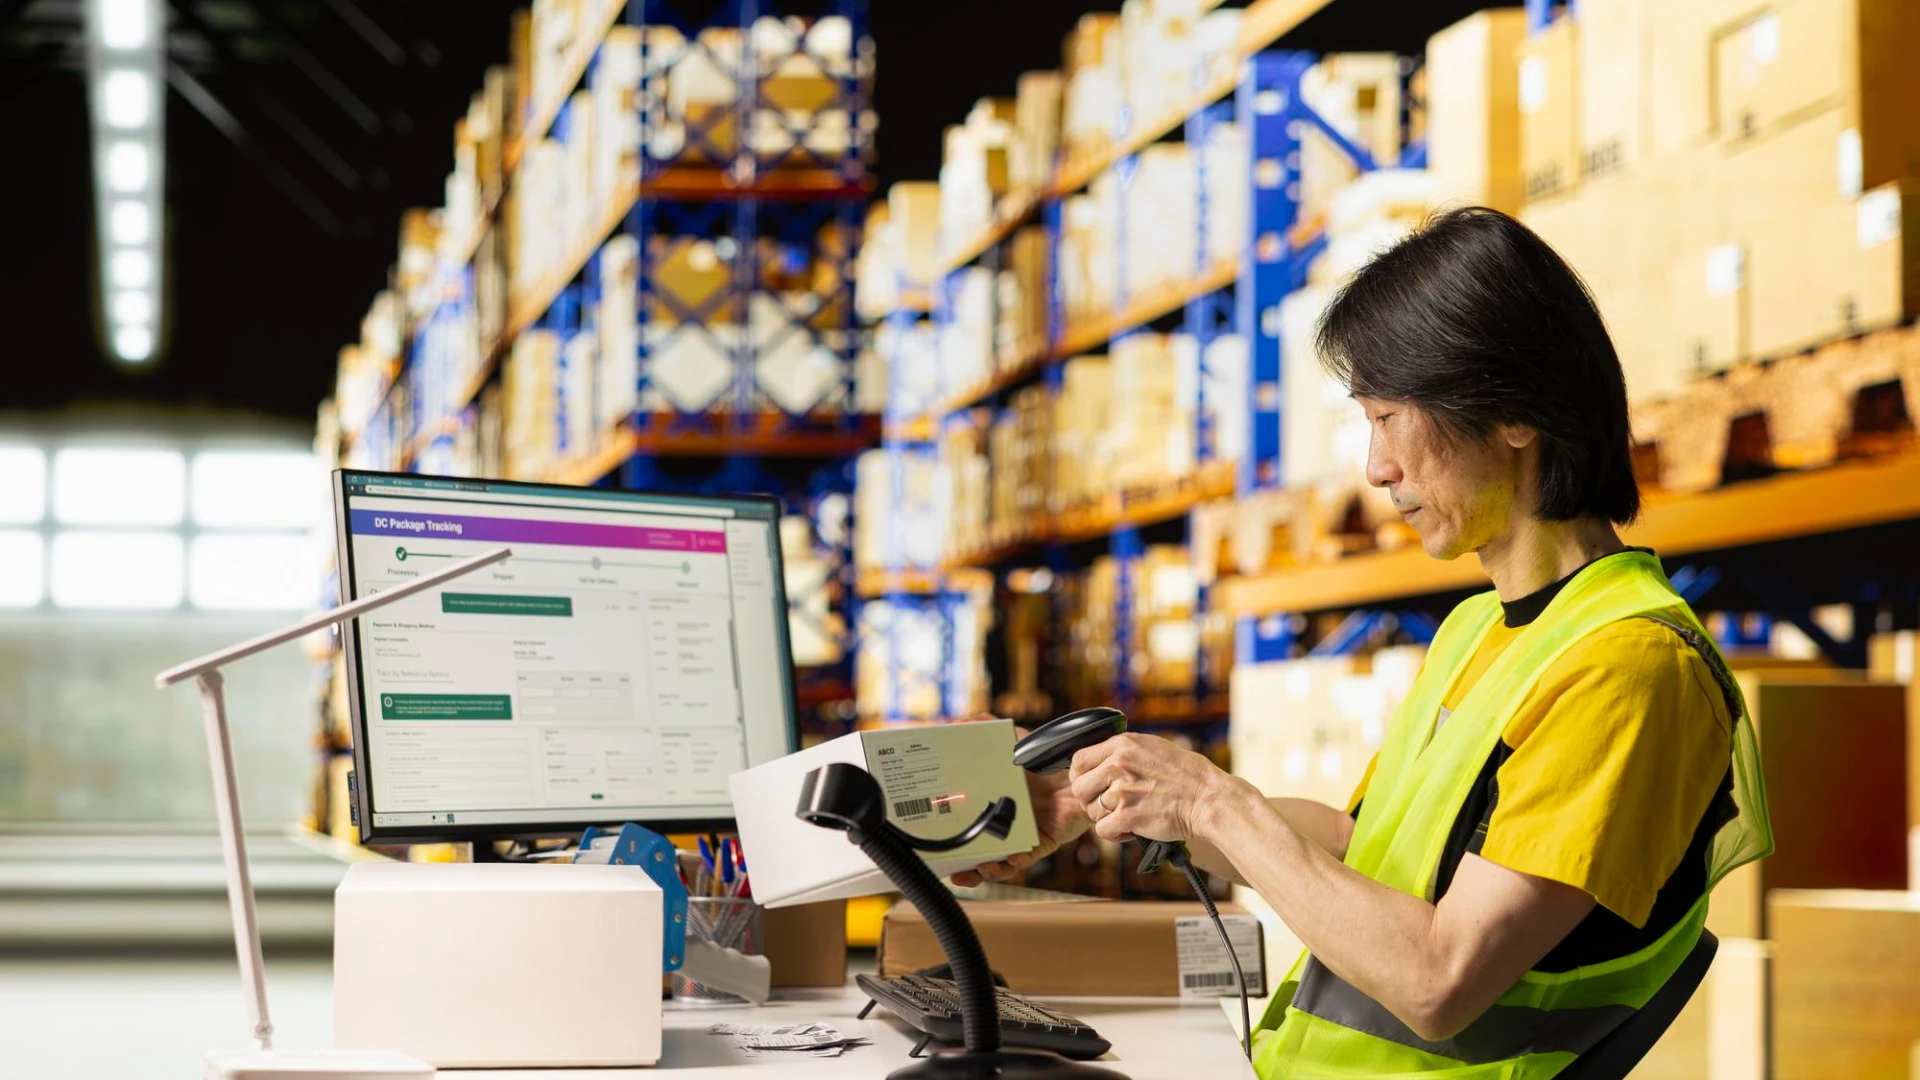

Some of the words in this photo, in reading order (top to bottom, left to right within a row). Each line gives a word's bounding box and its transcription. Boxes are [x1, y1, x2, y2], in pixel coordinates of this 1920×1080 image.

[374, 517, 388, 528] DC
[390, 518, 425, 532] Package
[427, 520, 462, 535] Tracking
[388, 568, 419, 577] Processing
